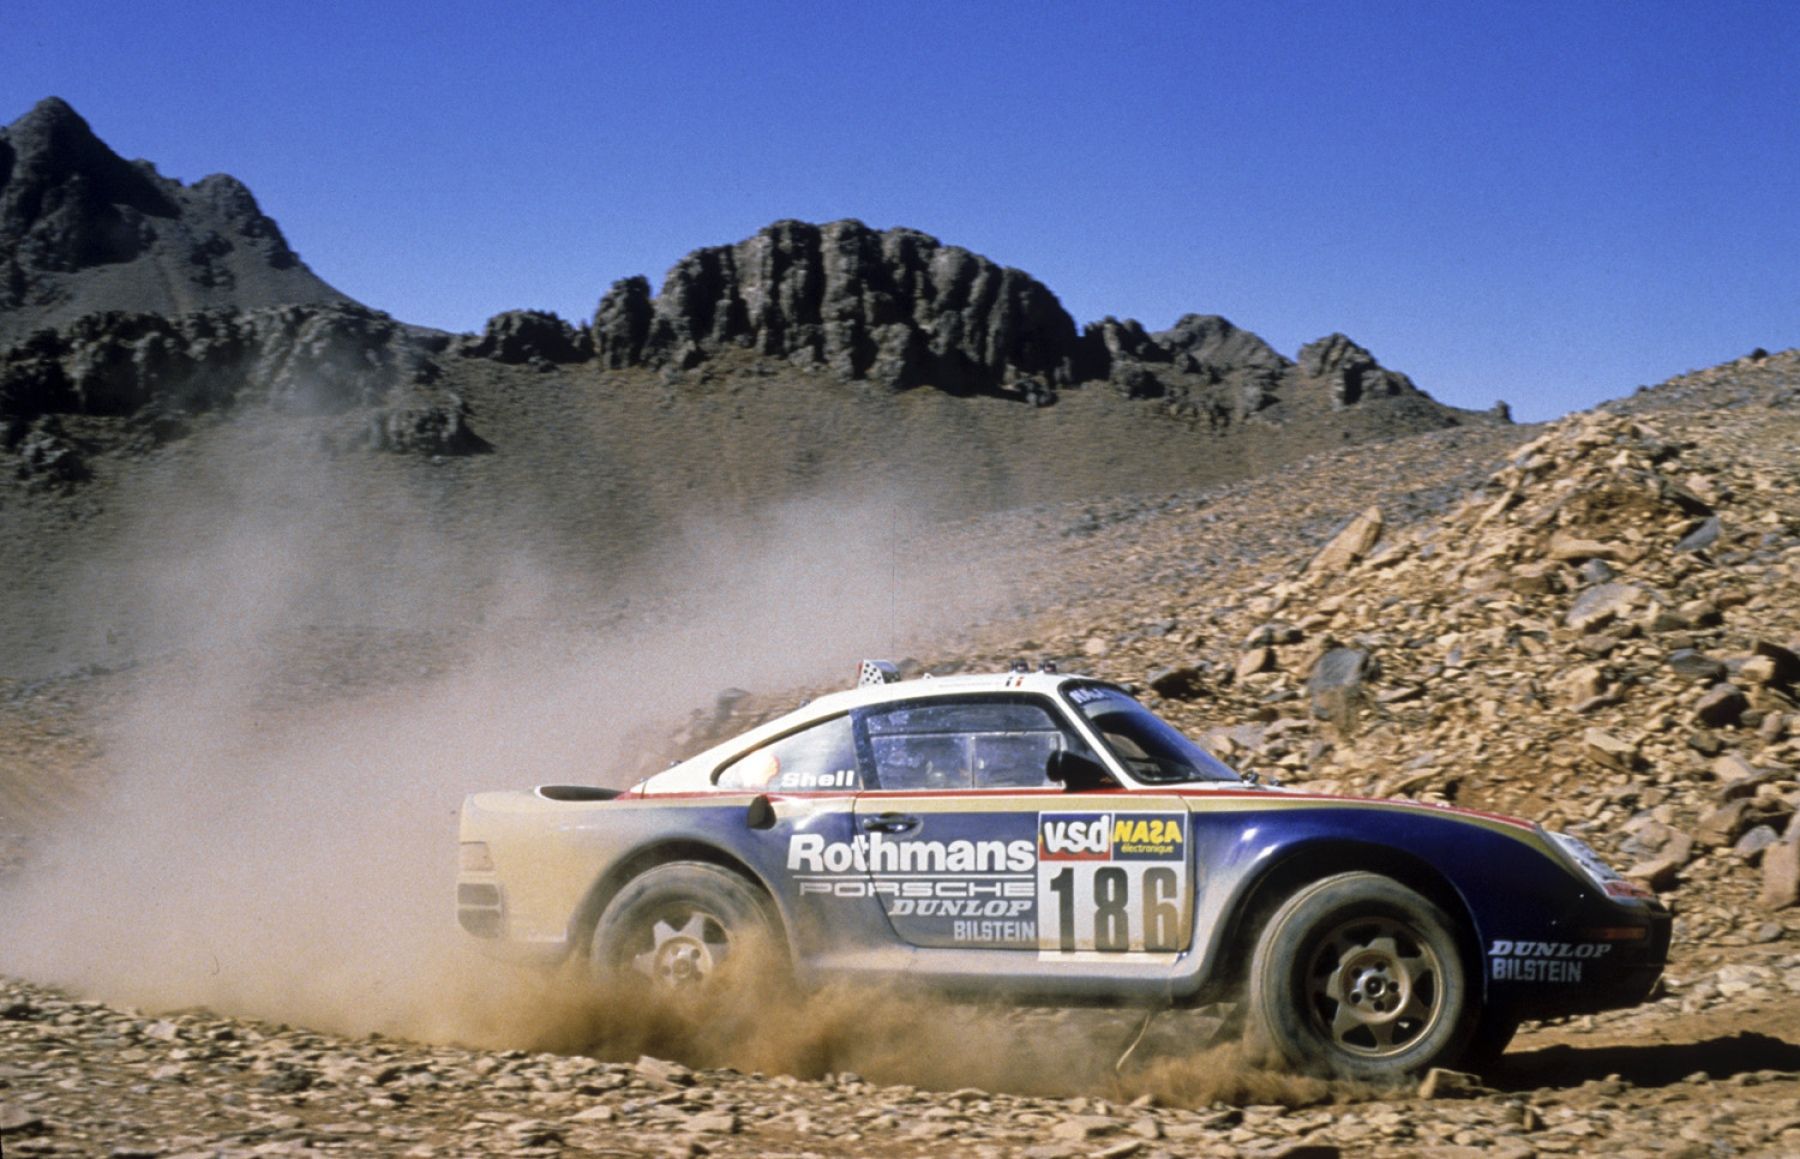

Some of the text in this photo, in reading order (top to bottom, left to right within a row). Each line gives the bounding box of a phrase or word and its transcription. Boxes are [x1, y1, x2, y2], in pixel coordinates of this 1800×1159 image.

[782, 770, 854, 787] Shell
[787, 832, 1035, 872] Rothmans
[800, 882, 1035, 897] PORSCHE
[888, 900, 1032, 916] DUNLOP
[1050, 866, 1178, 953] 186
[954, 921, 1034, 941] BILSTEIN
[1488, 940, 1612, 957] DUNLOP
[1492, 958, 1582, 981] BILSTEIN
